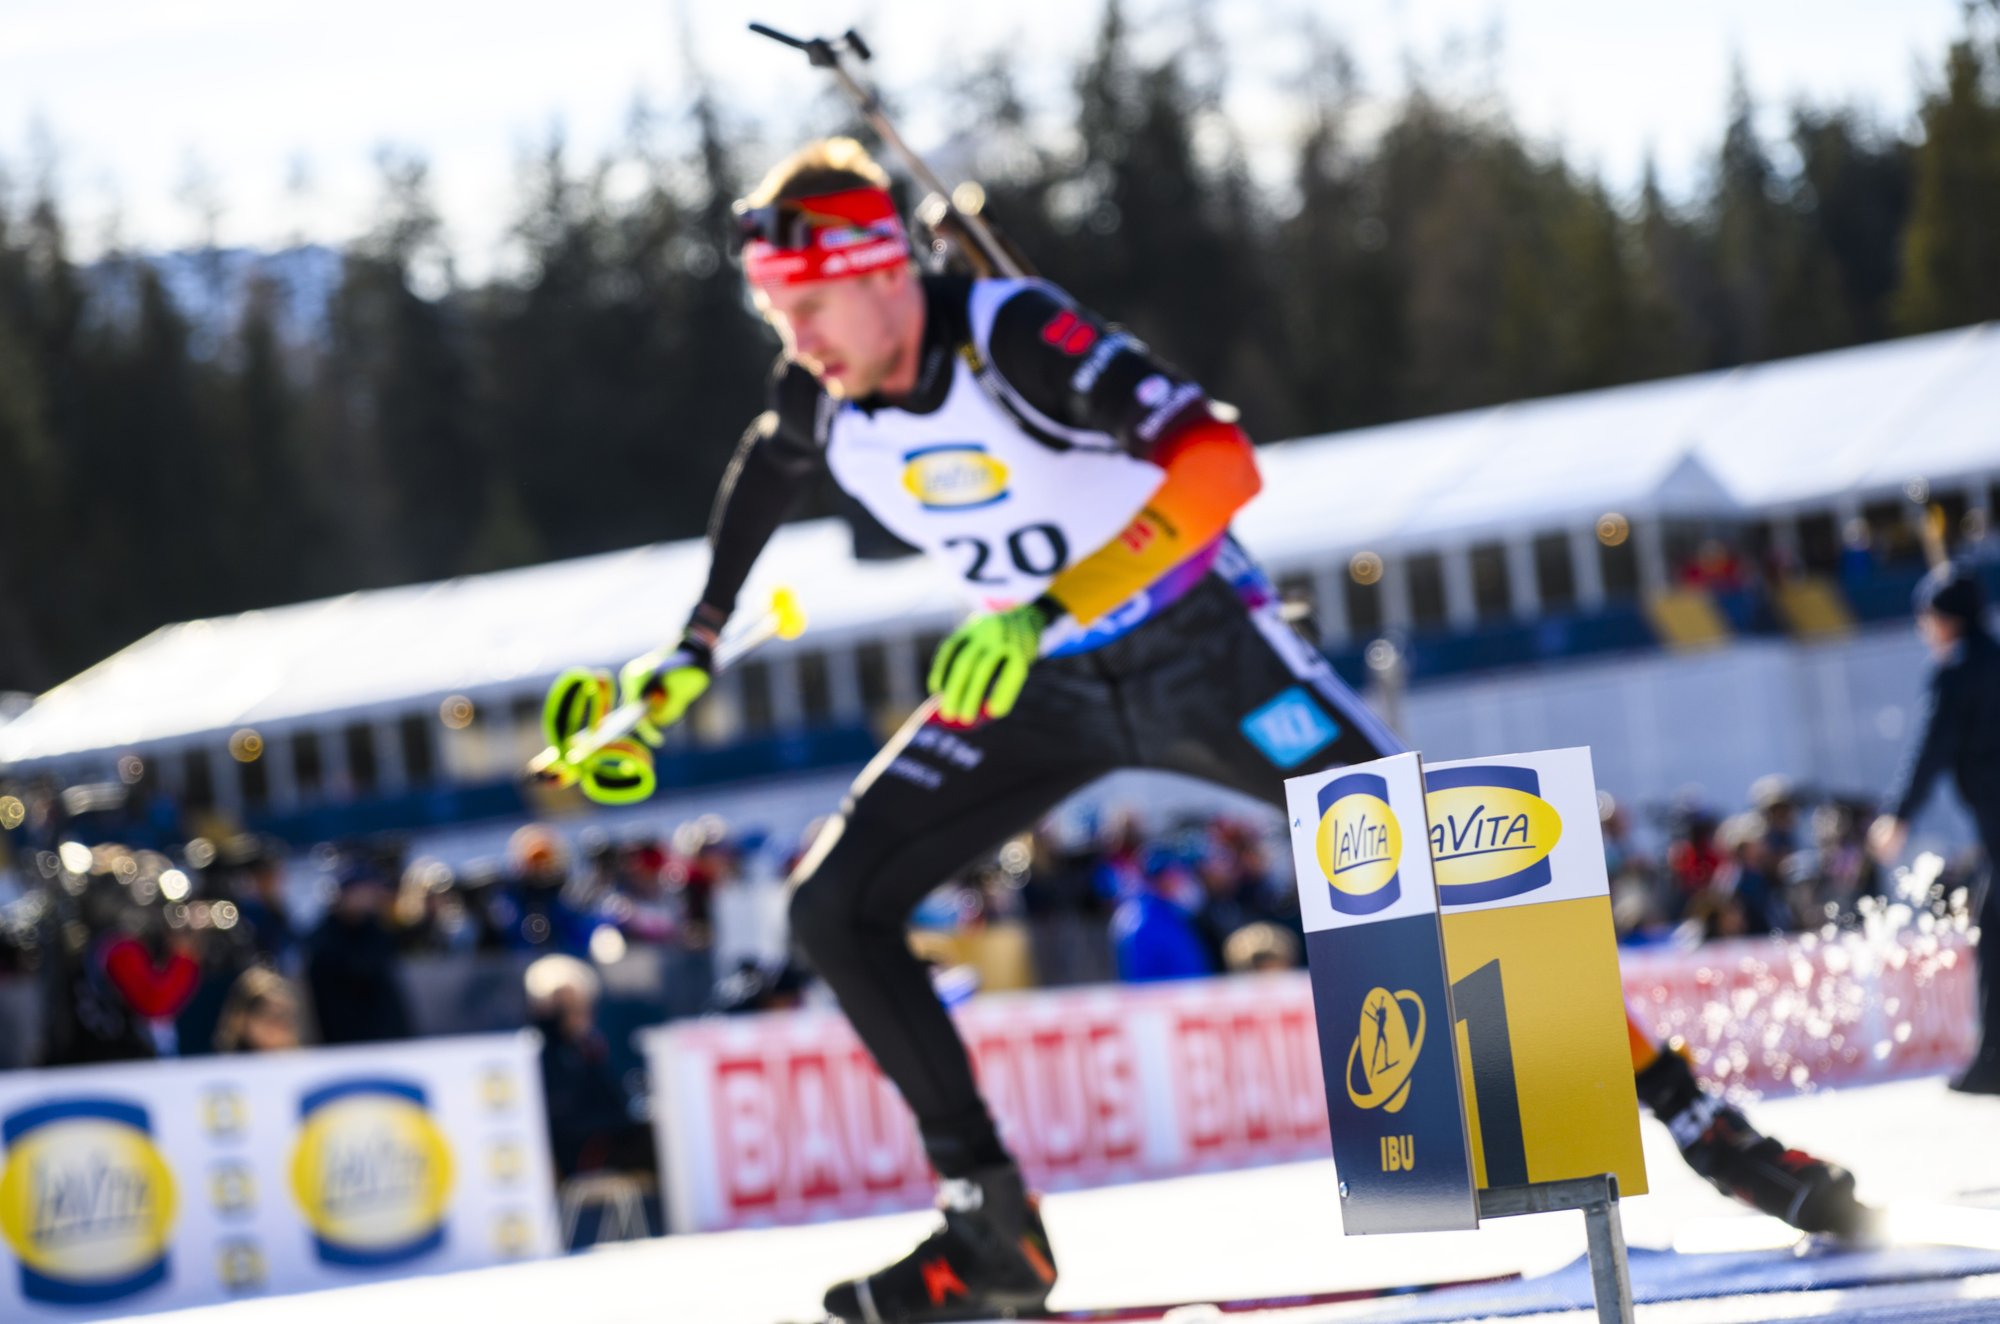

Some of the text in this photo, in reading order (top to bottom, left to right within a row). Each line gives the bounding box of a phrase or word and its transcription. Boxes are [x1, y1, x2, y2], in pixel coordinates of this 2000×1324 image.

[944, 523, 1069, 586] 20
[1333, 814, 1391, 874] LAVITA
[1430, 804, 1530, 856] AVITA
[1451, 957, 1529, 1188] 1
[715, 1023, 1138, 1208] BAUAUS
[1380, 1134, 1415, 1172] IBU
